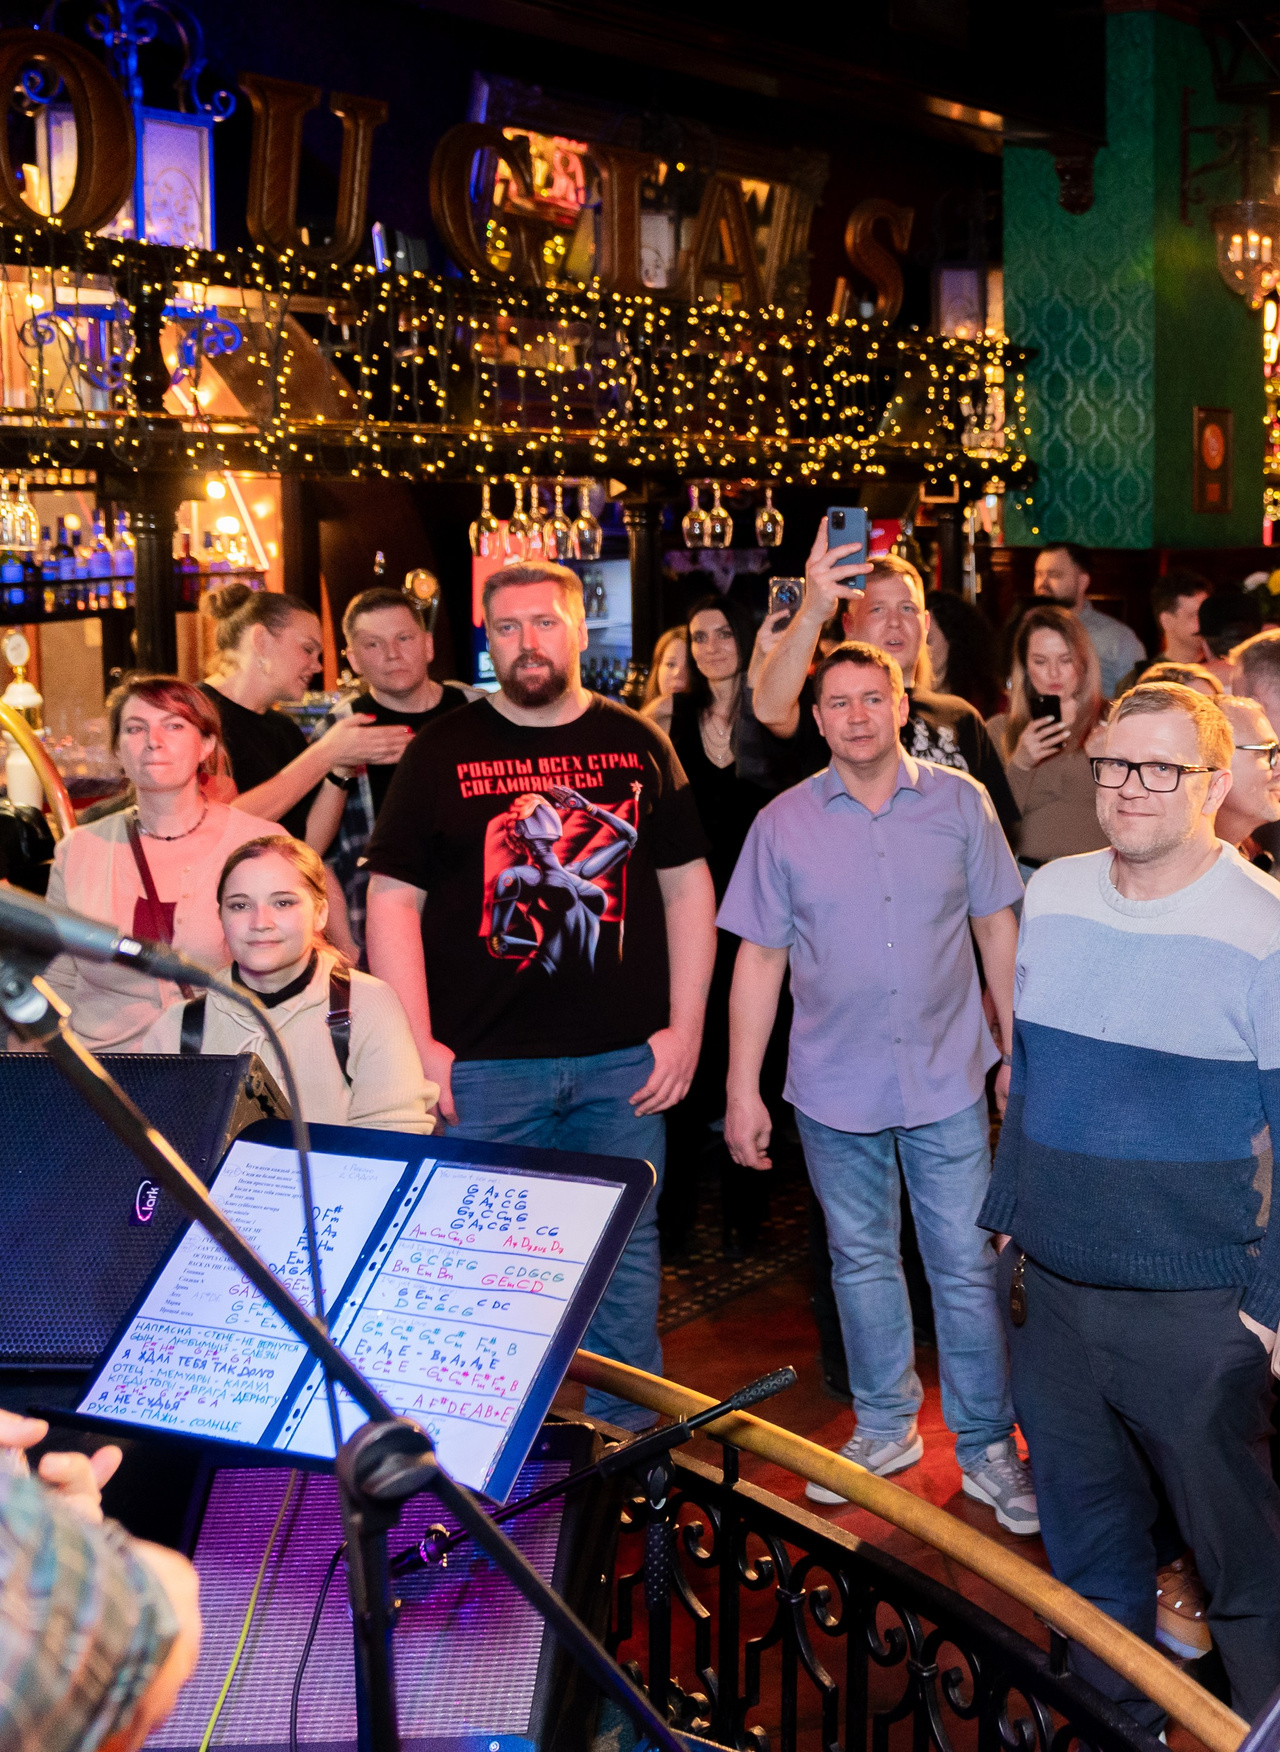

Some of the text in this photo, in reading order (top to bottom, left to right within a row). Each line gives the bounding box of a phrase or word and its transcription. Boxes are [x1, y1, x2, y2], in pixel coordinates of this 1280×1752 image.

[457, 752, 643, 780] РОБОТЫ ВСЕХ СТРАН,
[460, 771, 604, 799] СОЕДИНЯЙТЕСЬ!
[136, 1180, 159, 1221] Clark
[467, 1184, 528, 1199] G A7 C G
[462, 1195, 527, 1211] G A7 C G
[457, 1206, 528, 1222] G7 C Cm G
[450, 1219, 465, 1229] G
[468, 1219, 483, 1232] A7
[487, 1222, 497, 1230] C
[499, 1223, 510, 1231] G
[286, 1251, 304, 1265] Em
[410, 1252, 565, 1282] G C G F G C D G C G
[392, 1260, 544, 1293] Bm Em Bm G Em C D
[395, 1298, 474, 1317] D C G C G
[398, 1288, 408, 1297] G
[416, 1290, 433, 1301] Em
[440, 1294, 449, 1302] C
[477, 1299, 487, 1307] C
[492, 1301, 500, 1309] D
[135, 1322, 299, 1353] НАПРАСНА СТЕНЕ НЕ ВЕРНУТСЯ
[168, 1336, 229, 1353] ЛЮБИМЫЙ
[507, 1343, 517, 1356] B
[121, 1349, 131, 1359] Я
[138, 1350, 170, 1366] ЖДАЛ
[178, 1356, 208, 1370] ТЕБЯ
[213, 1361, 237, 1375] ТАК
[113, 1363, 269, 1393] ОТЕЦ МЕМУАРЫ КАРАУЛ
[98, 1392, 180, 1412] Я НЕ СУДЬЯ
[87, 1402, 241, 1433] РУСЛО ПАЖИ СОЛНЦЕ
